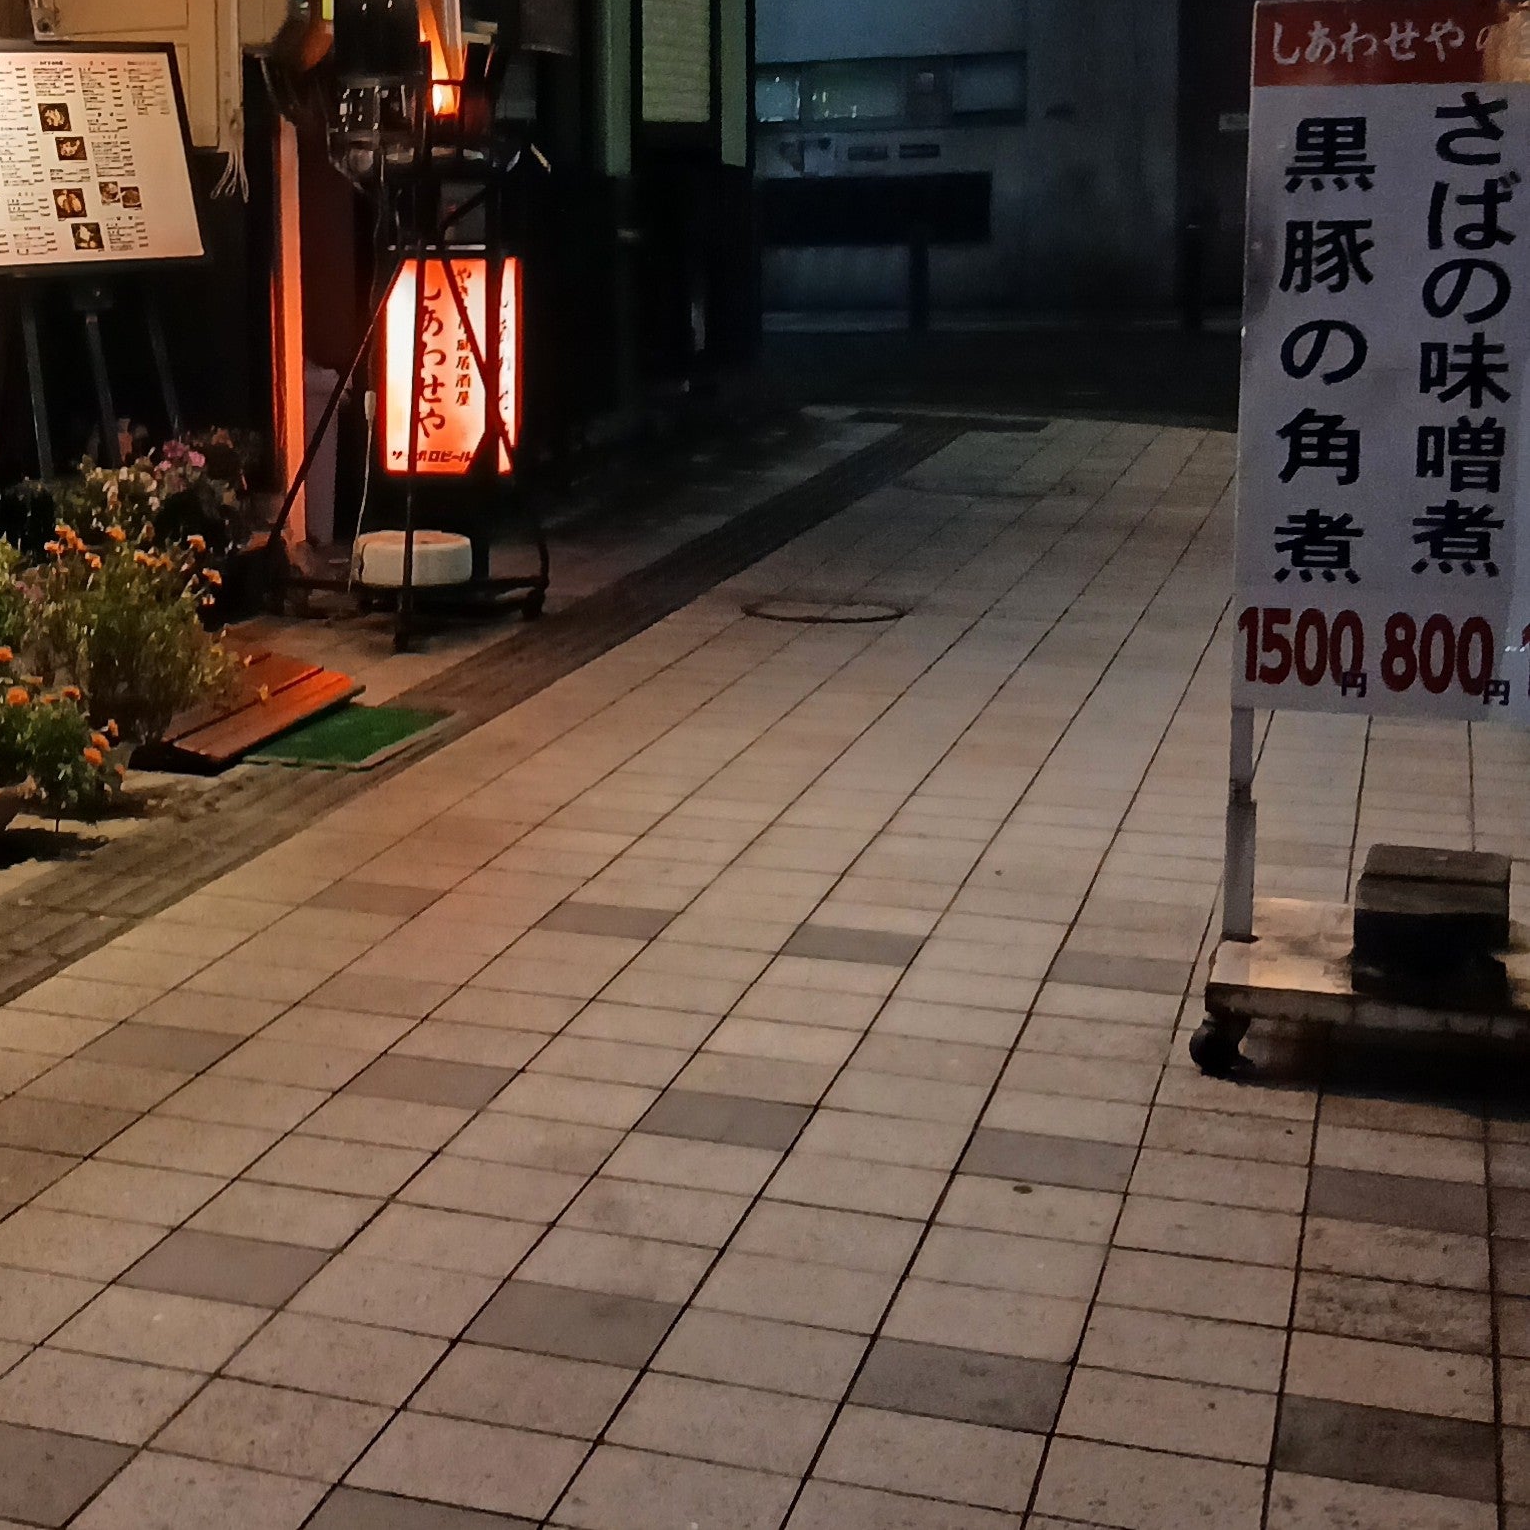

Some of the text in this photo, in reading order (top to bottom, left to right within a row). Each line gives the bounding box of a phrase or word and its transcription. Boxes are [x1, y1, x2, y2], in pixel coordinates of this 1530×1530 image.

[1272, 115, 1376, 585] 黒豚の角煮
[1410, 90, 1522, 578] さばの味噌煮
[1238, 606, 1367, 698] 1500円
[1380, 611, 1511, 706] 800円
